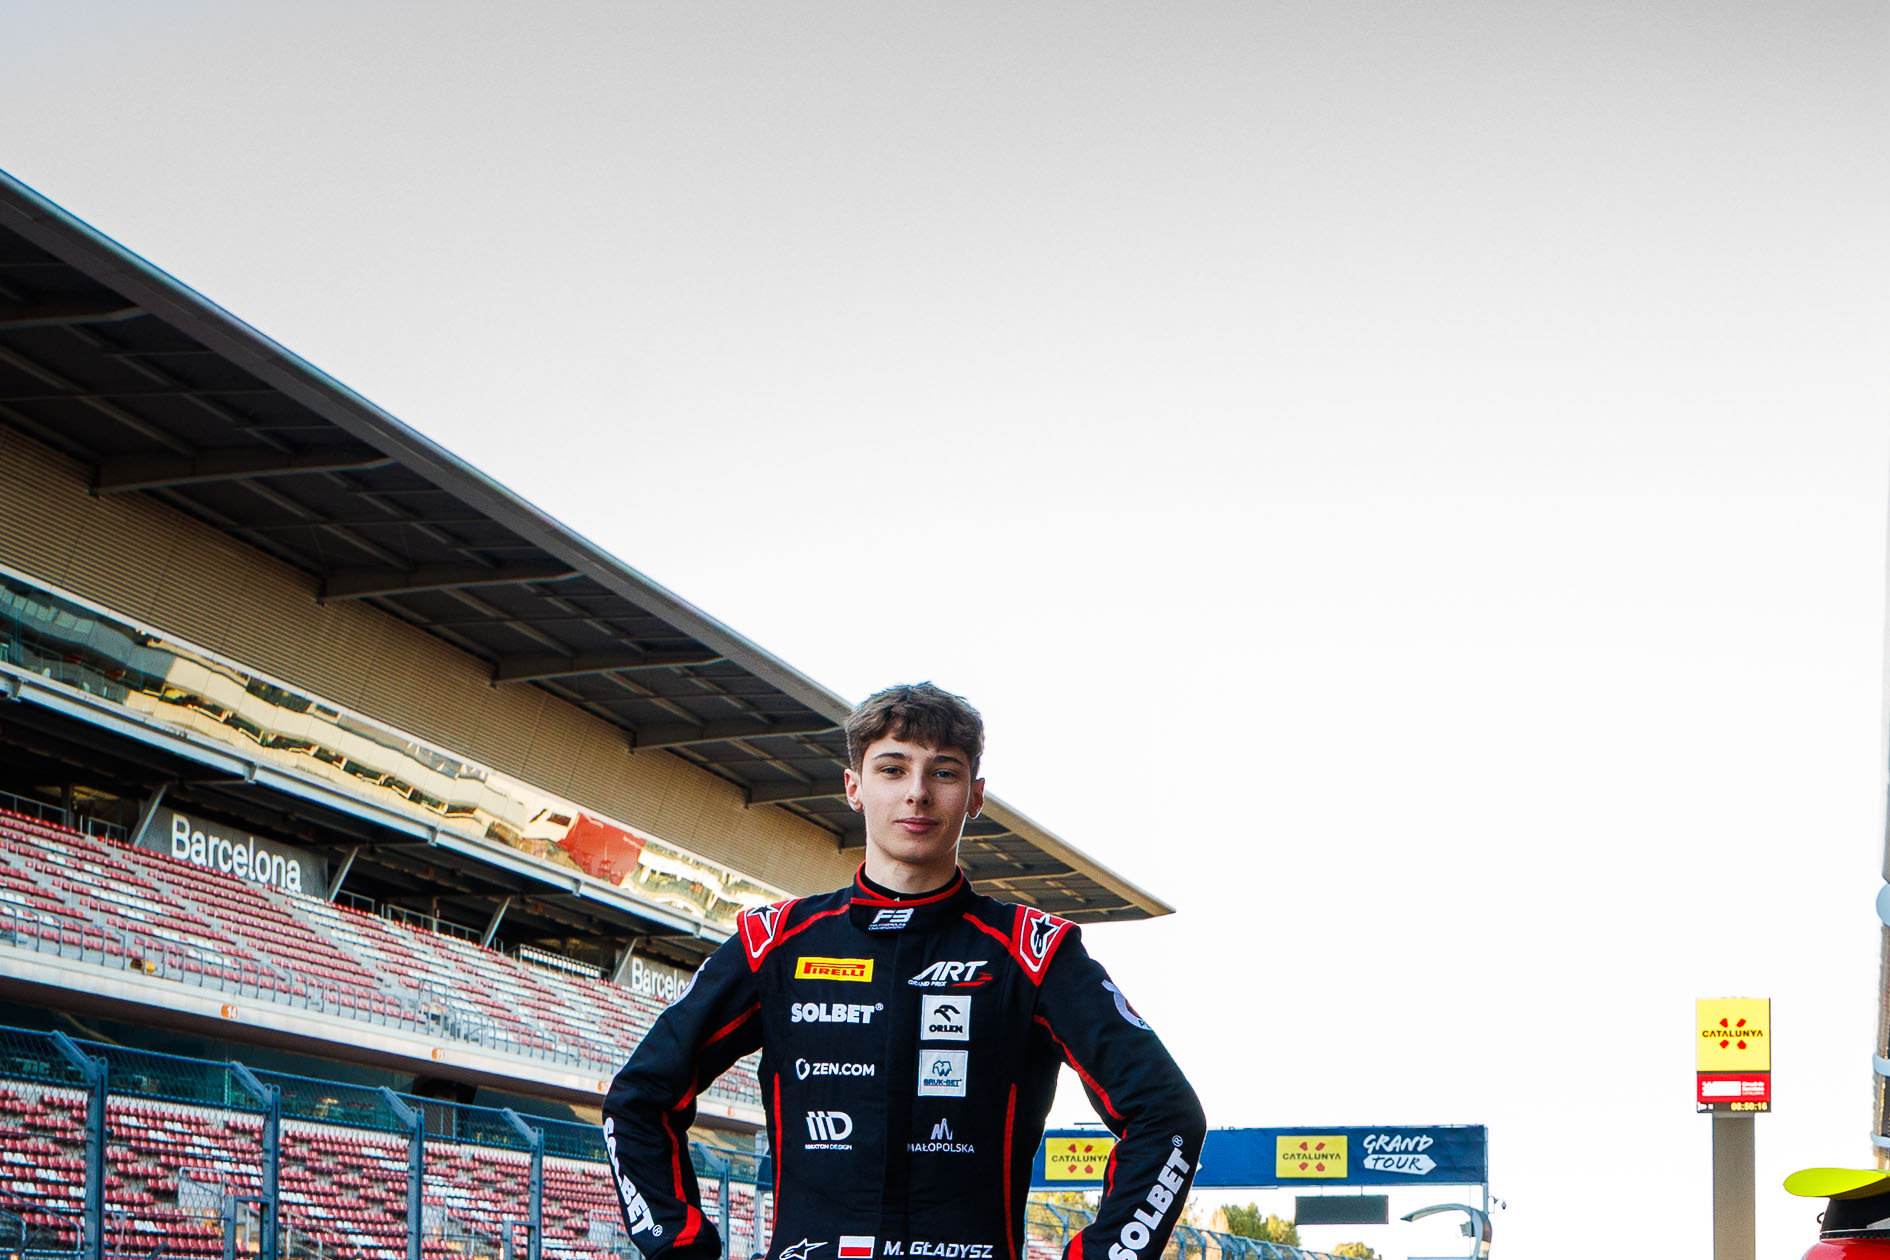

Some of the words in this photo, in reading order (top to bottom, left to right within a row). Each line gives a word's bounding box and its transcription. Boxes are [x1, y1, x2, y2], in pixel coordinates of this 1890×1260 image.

[171, 812, 303, 894] Barcelona
[872, 907, 915, 925] F3
[803, 961, 867, 978] PIRELLI
[911, 961, 988, 983] ART
[632, 957, 690, 1002] Barcelo
[928, 1023, 964, 1035] ORLEN
[1702, 1029, 1764, 1038] CATALUNYA
[812, 1062, 875, 1078] ZEN.COM
[923, 1079, 962, 1087] BRUK-BET
[907, 1142, 976, 1154] MAŁOPOLSKA
[1362, 1133, 1434, 1155] GRAND
[1282, 1152, 1342, 1162] CATALUNYA
[1371, 1155, 1425, 1171] TOUR
[883, 1240, 905, 1256] M.
[909, 1241, 994, 1259] GŁADYSZ
